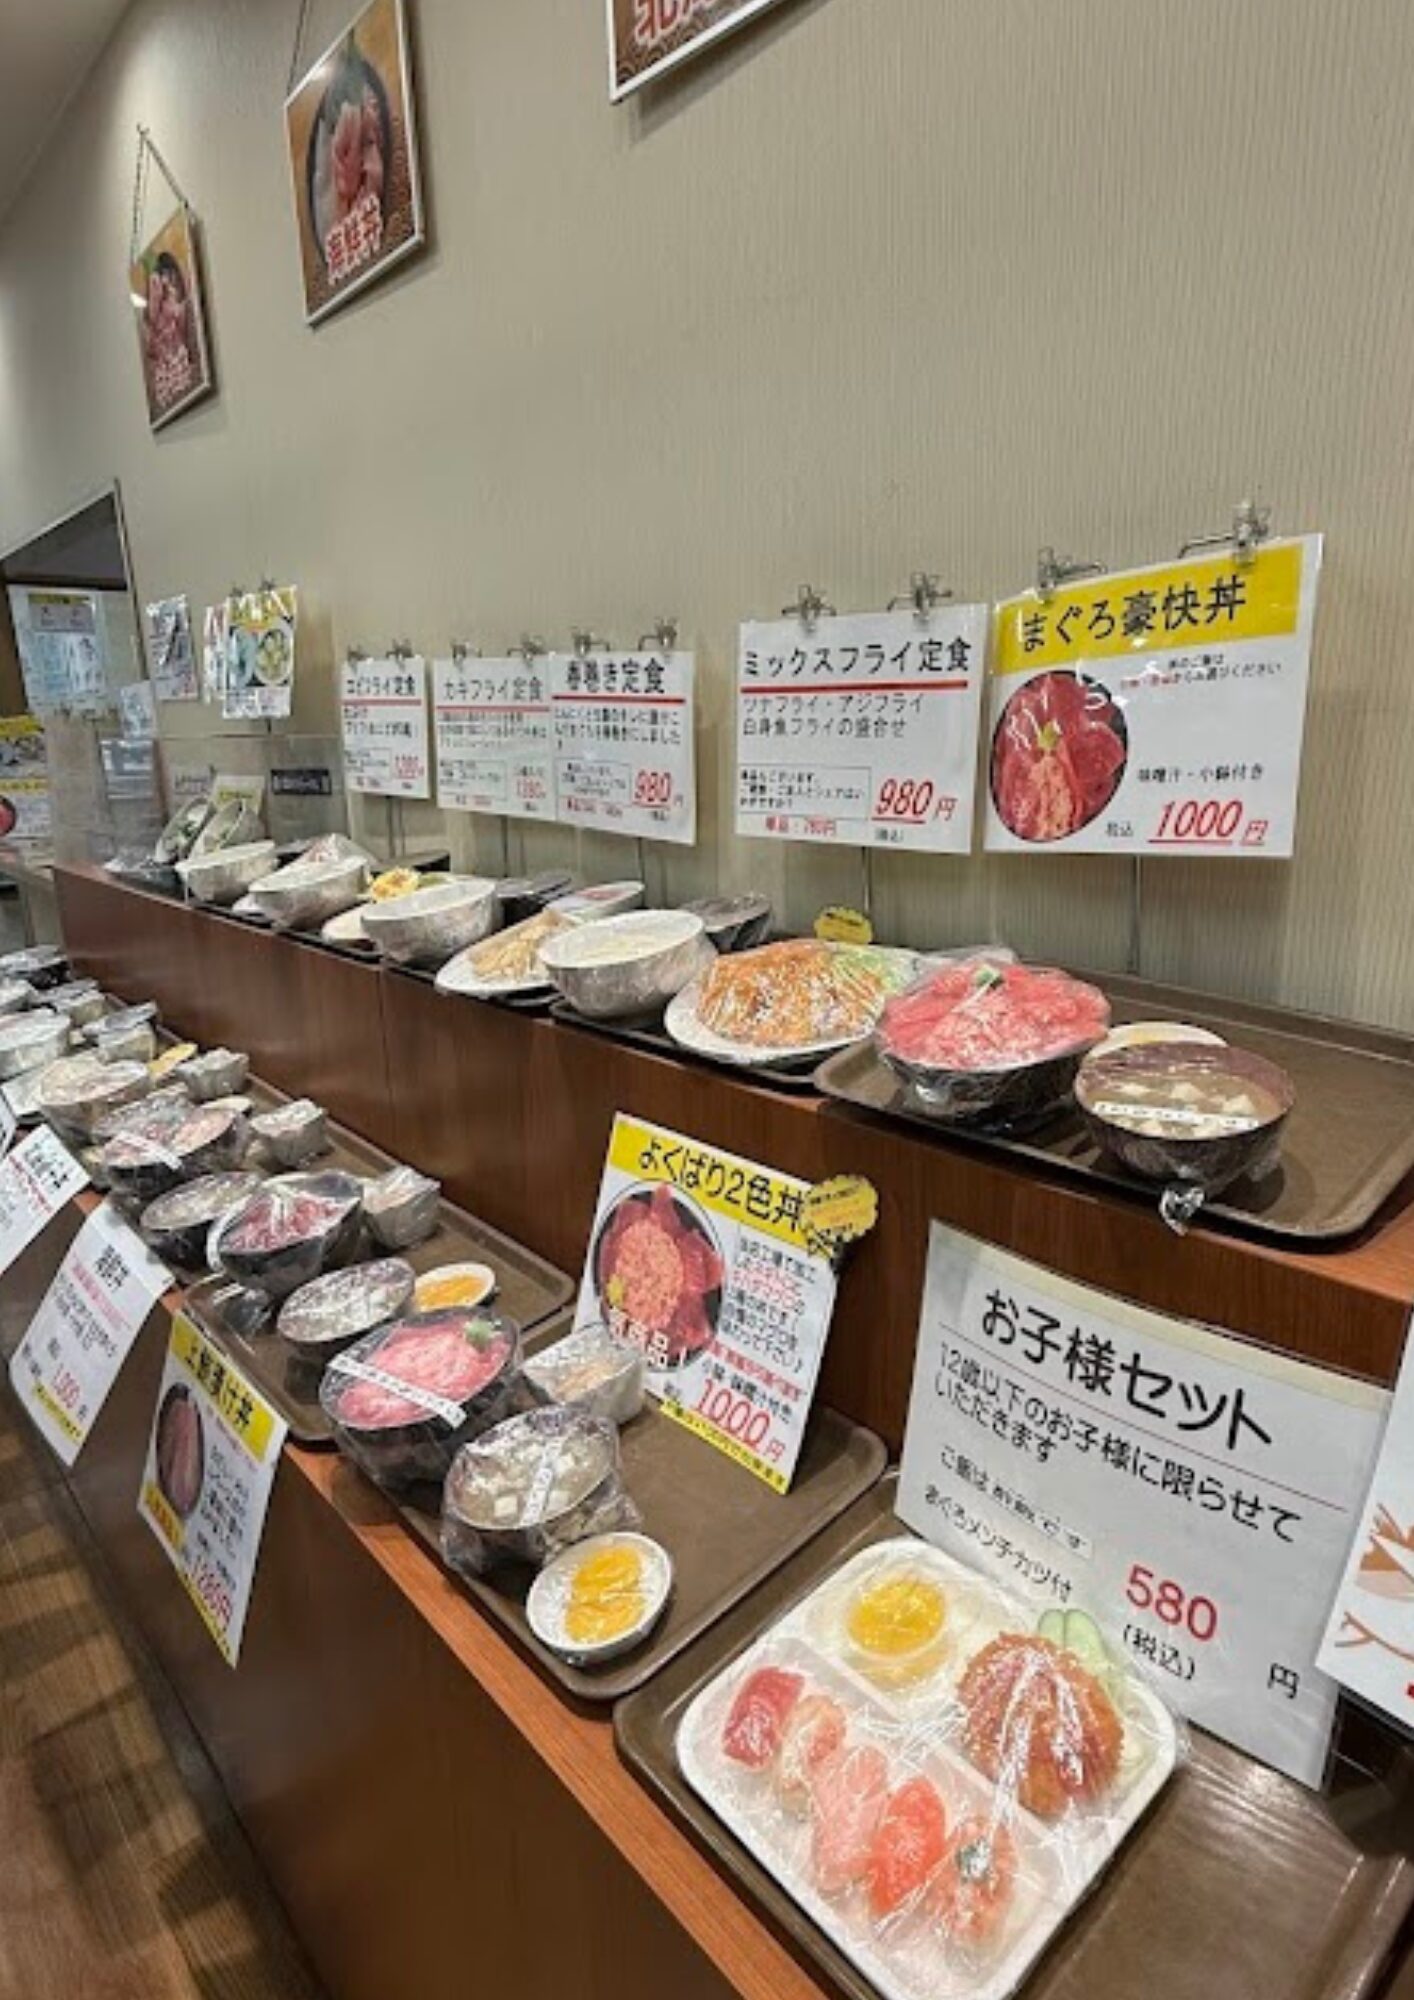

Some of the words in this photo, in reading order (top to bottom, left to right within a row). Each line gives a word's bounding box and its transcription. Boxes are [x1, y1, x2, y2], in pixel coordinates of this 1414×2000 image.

[1023, 575, 1246, 651] まぐろ豪快丼
[566, 658, 665, 693] 春巻き定食
[745, 636, 971, 677] ミックスフライ定食
[743, 717, 906, 738] 白身魚フライの盛合せ
[639, 1138, 803, 1233] よくばり2色丼
[981, 1289, 1272, 1451] お子様セット
[934, 1369, 1058, 1463] いただきます
[938, 1342, 1305, 1545] 12歳以下のお子様に限らせて
[925, 1483, 1073, 1603] まぐろメンチカツ付
[1125, 1563, 1219, 1642] 580
[1123, 1622, 1197, 1681] (税込)
[1268, 1661, 1298, 1701] 円
